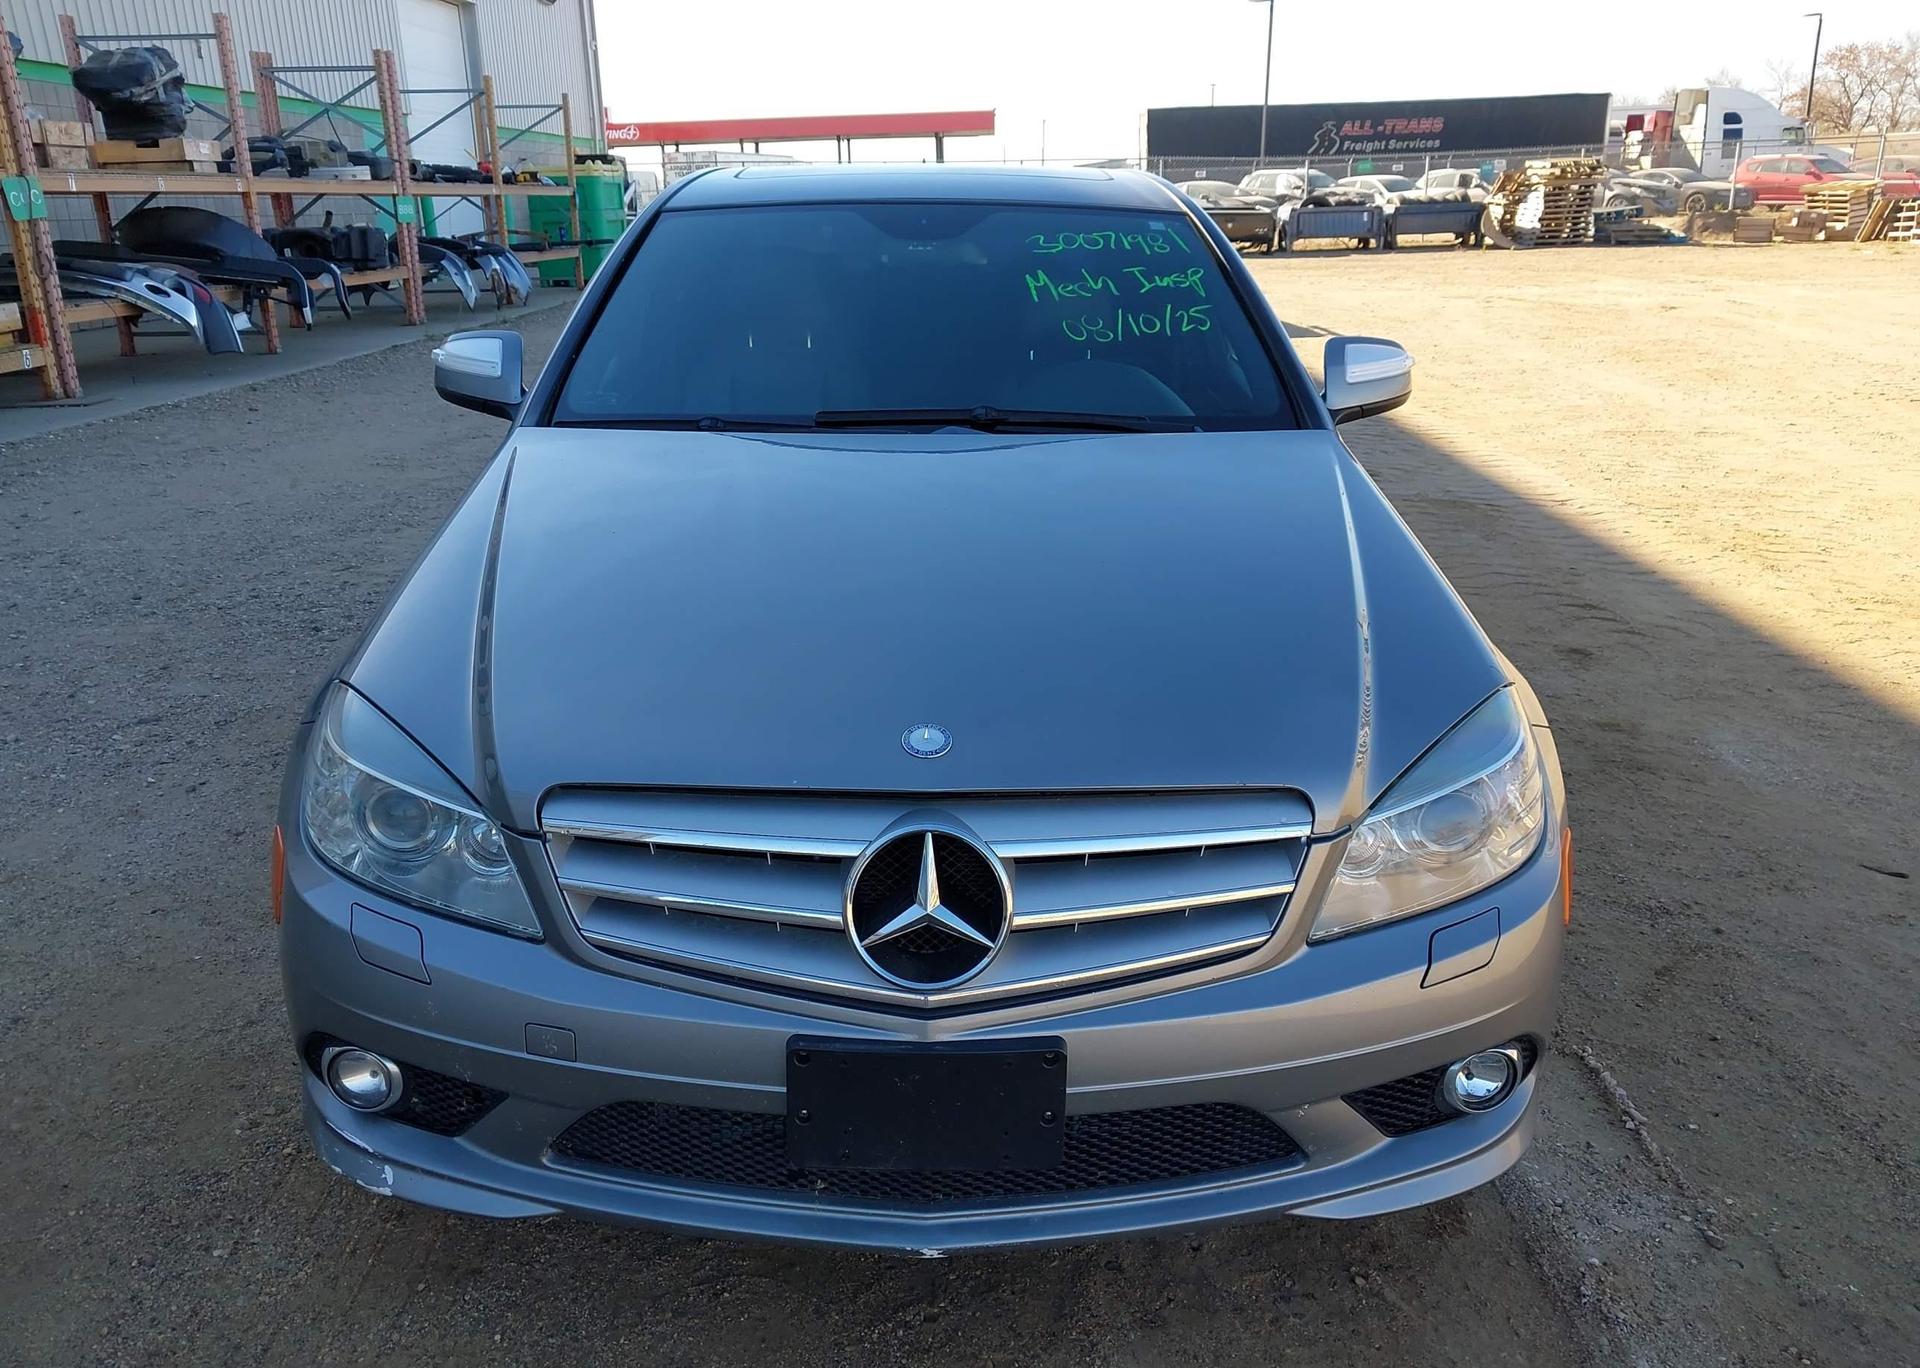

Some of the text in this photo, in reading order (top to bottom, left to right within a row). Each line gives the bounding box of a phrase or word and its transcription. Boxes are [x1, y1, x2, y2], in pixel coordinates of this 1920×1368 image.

[1343, 139, 1441, 152] Freight Services
[1025, 228, 1191, 254] 30071981
[1025, 268, 1120, 302] Mech
[1062, 303, 1213, 343] 08/10/25
